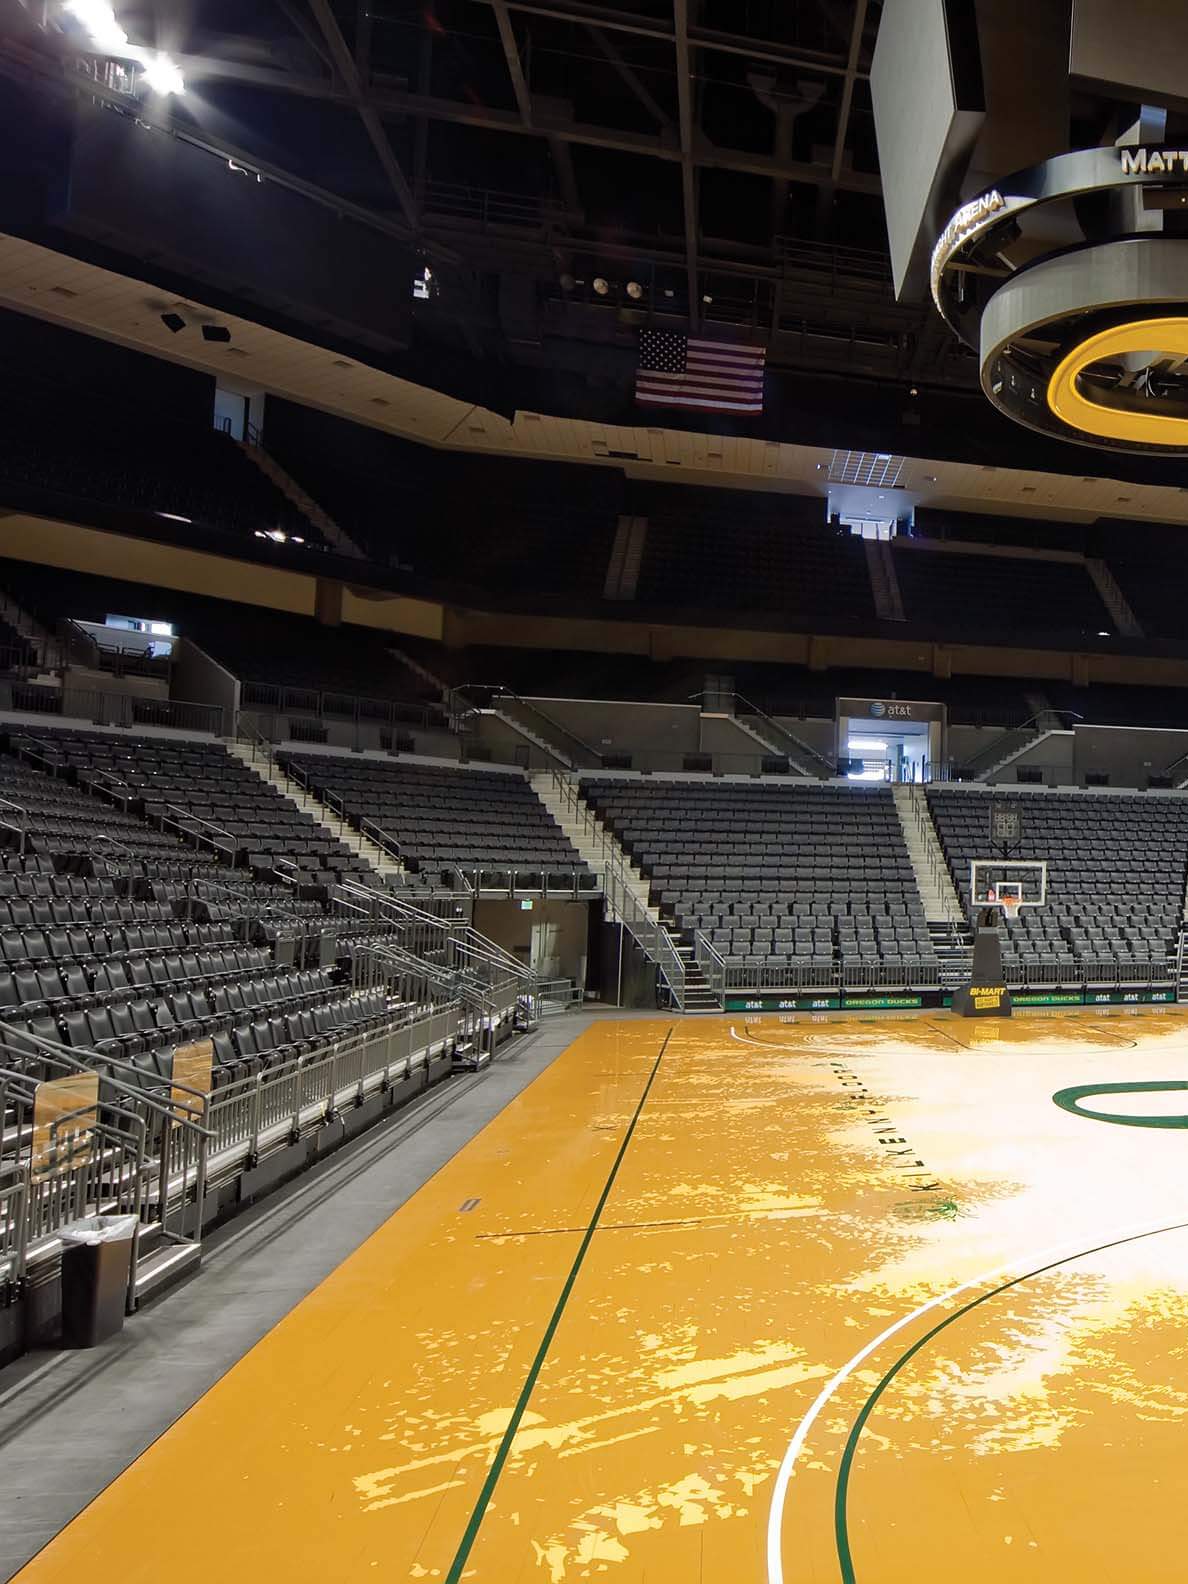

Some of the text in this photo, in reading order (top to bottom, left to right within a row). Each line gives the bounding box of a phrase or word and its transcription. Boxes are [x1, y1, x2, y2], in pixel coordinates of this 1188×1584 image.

[887, 704, 911, 716] at&t
[969, 987, 1006, 996] BI-MART
[1095, 993, 1110, 1001] at&t
[1124, 993, 1138, 1001] at&t
[1152, 992, 1166, 1000] at&t
[745, 1000, 763, 1009] at&t
[779, 1000, 796, 1008] at&t
[812, 999, 829, 1008] at&t
